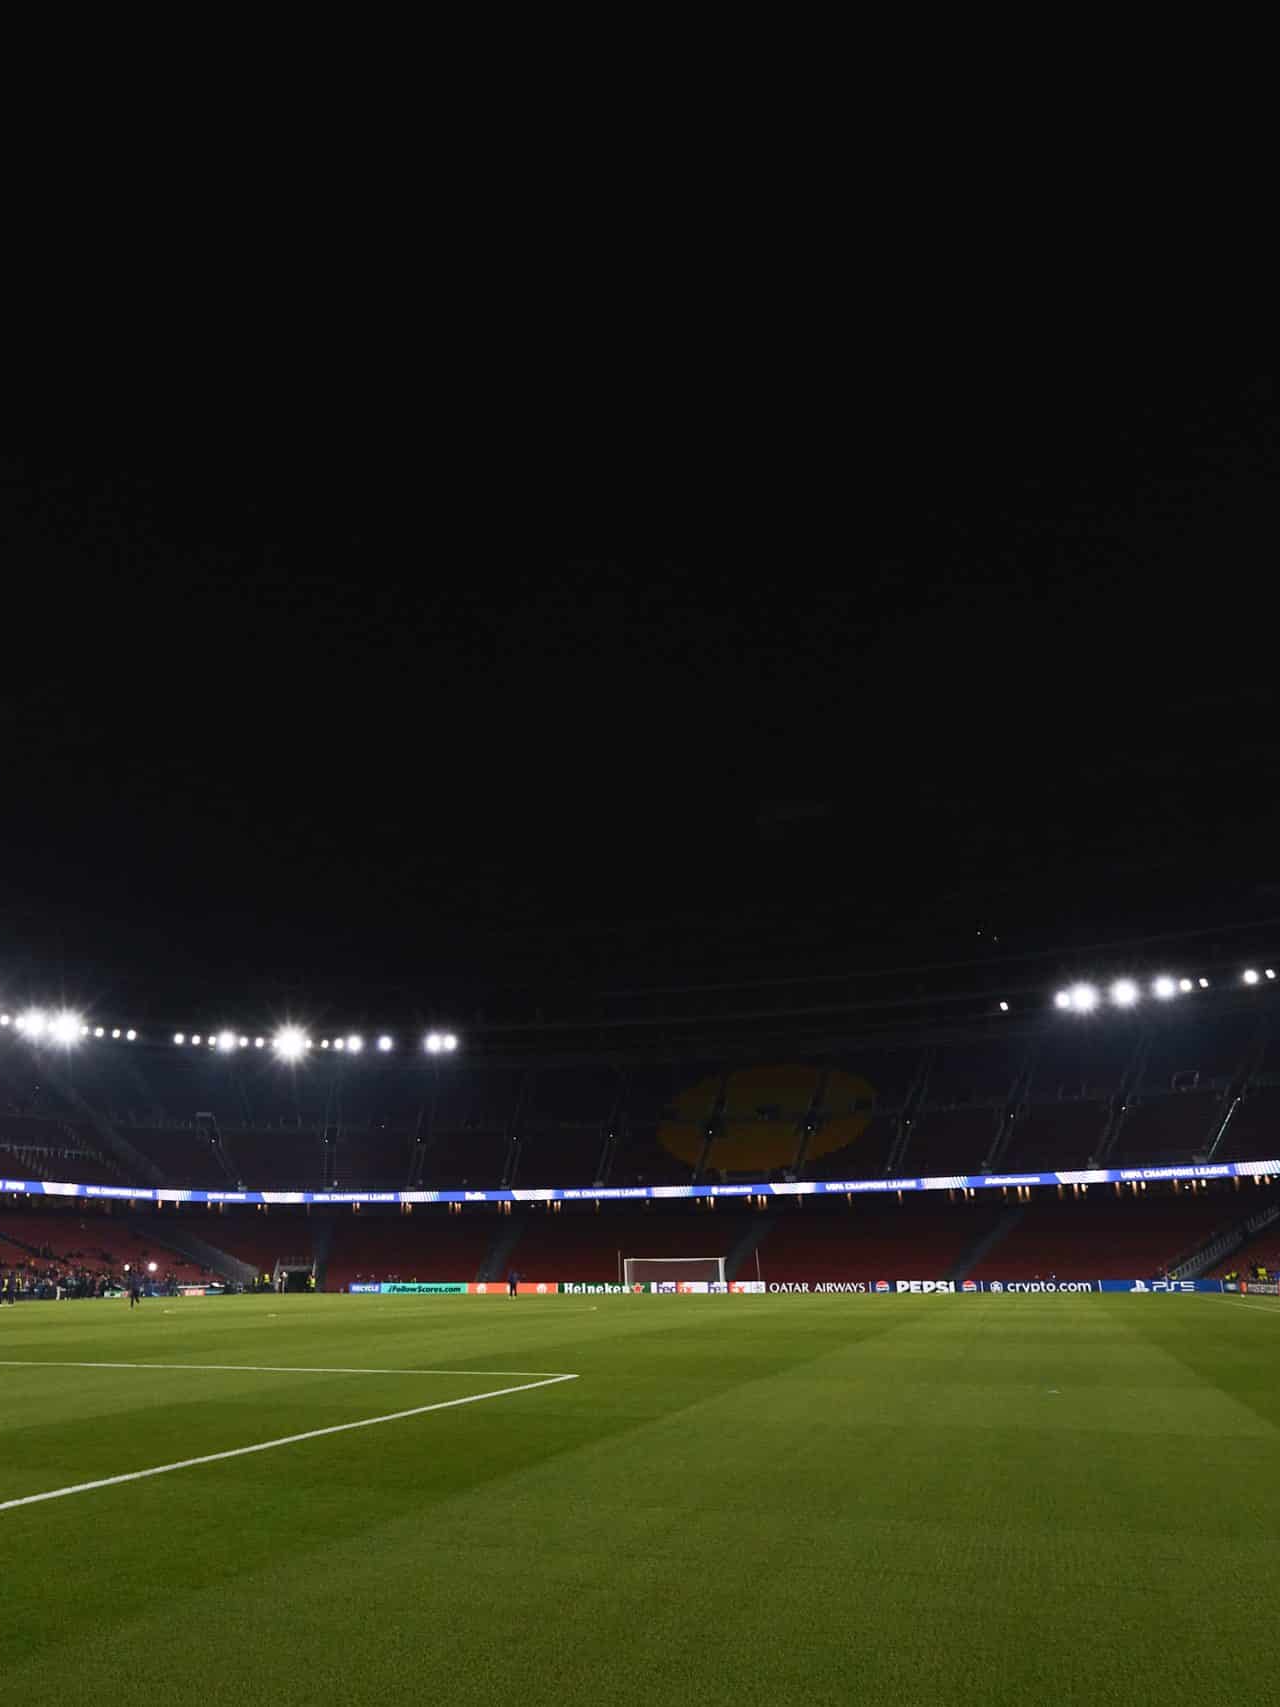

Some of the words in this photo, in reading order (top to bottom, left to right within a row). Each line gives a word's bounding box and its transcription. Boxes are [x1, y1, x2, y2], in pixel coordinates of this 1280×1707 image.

[564, 1282, 630, 1293] Heineken
[769, 1282, 809, 1293] QATAR
[814, 1282, 865, 1293] AIRWAYS
[896, 1281, 956, 1293] PEPSI
[1007, 1281, 1092, 1293] crypto.com
[1152, 1281, 1196, 1292] PS5
